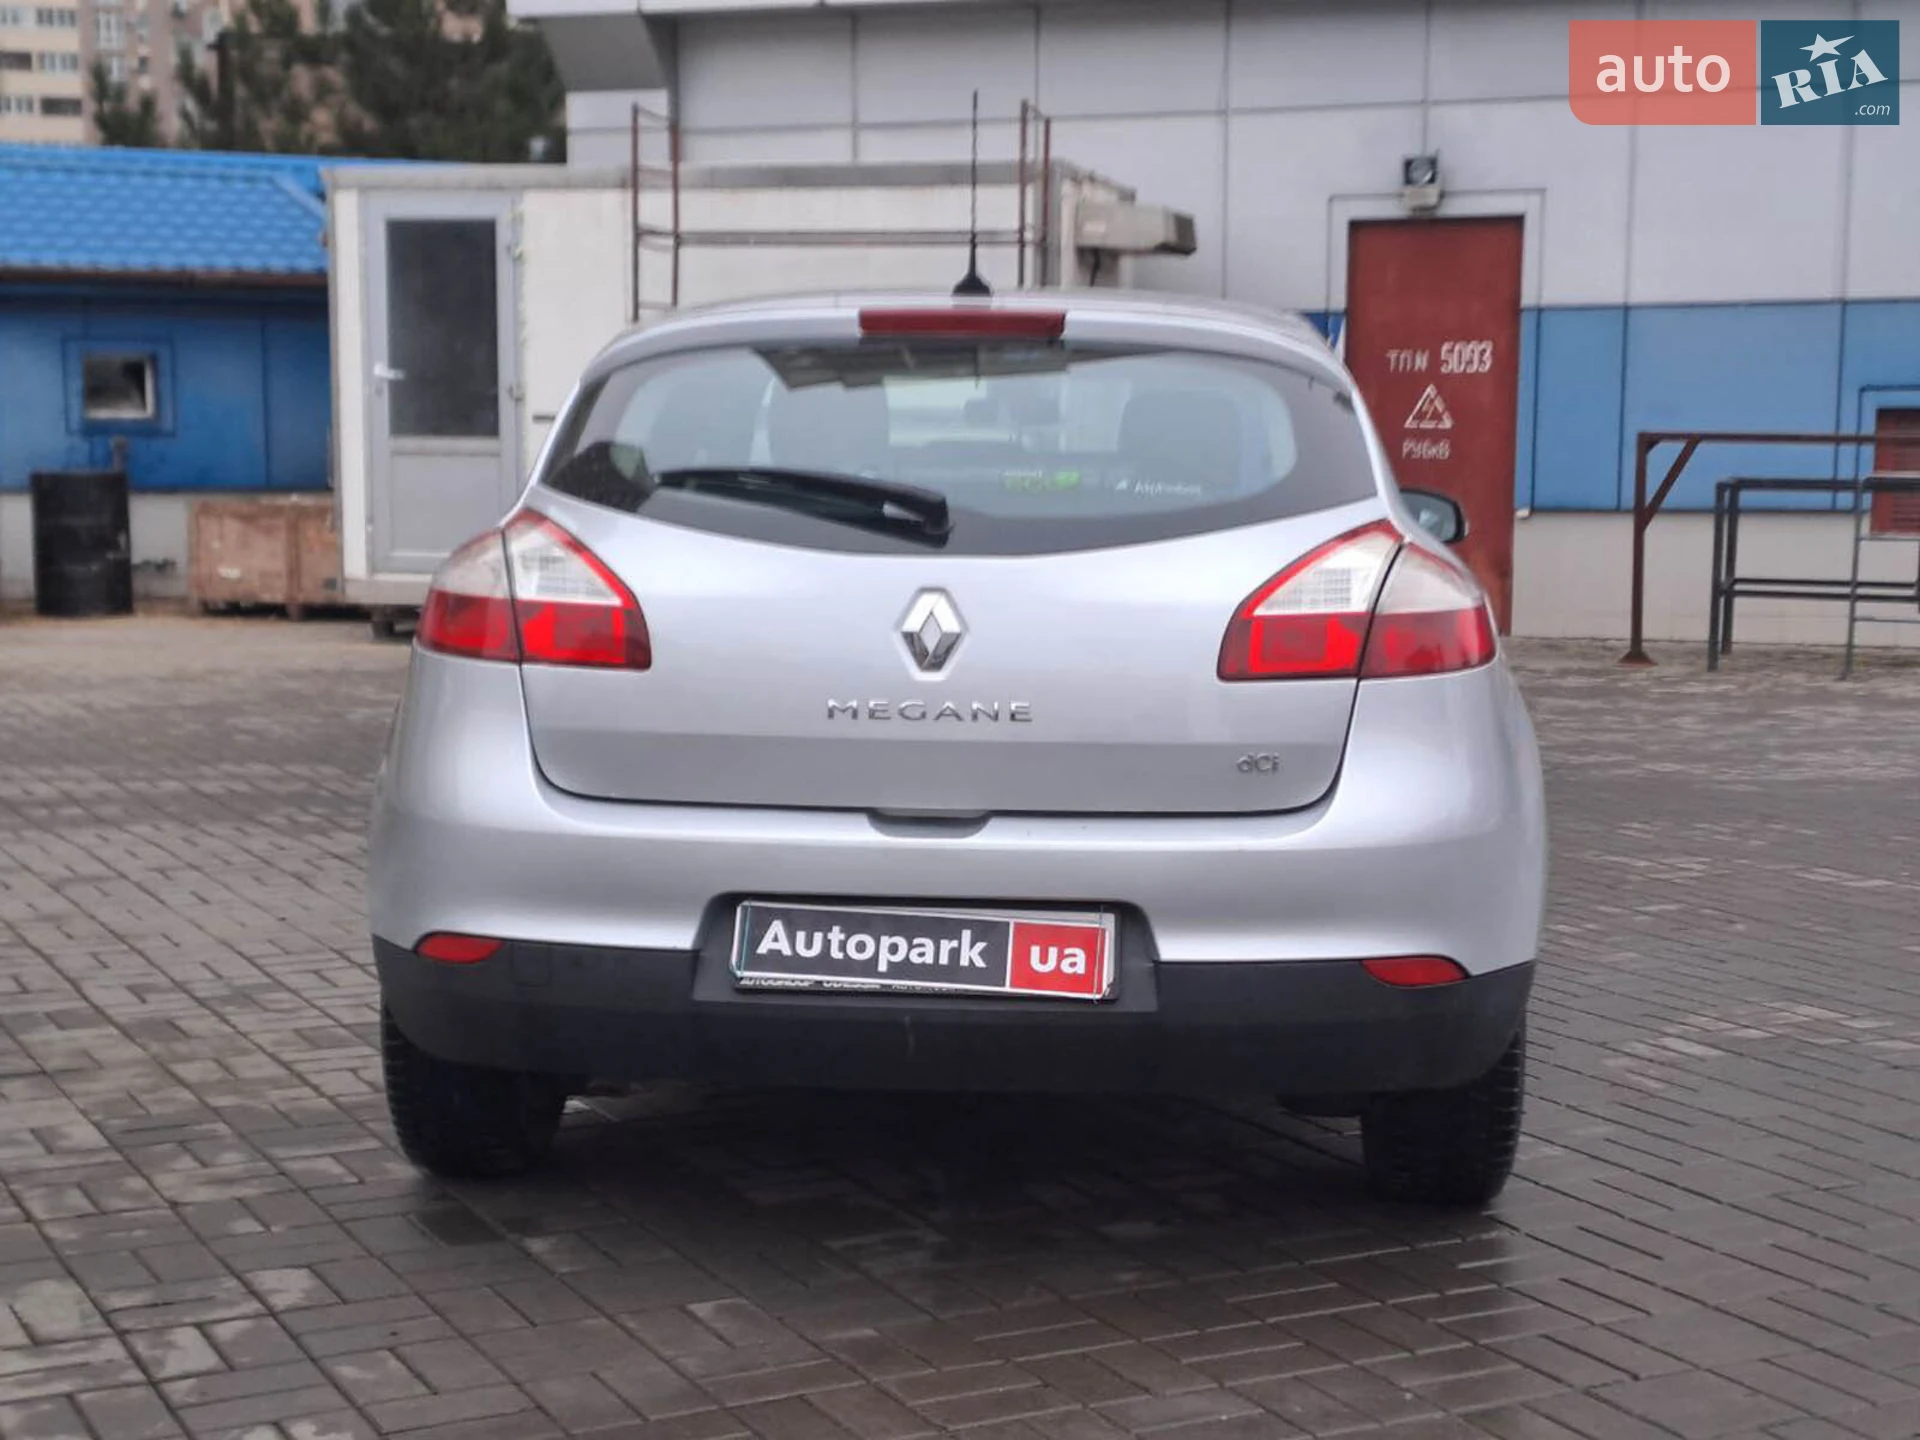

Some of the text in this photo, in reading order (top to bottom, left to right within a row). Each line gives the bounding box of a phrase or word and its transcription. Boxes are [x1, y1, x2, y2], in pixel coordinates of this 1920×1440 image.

[1440, 340, 1493, 373] 5093
[827, 699, 1033, 722] MEGANE
[756, 919, 1086, 975] Autopark ua
